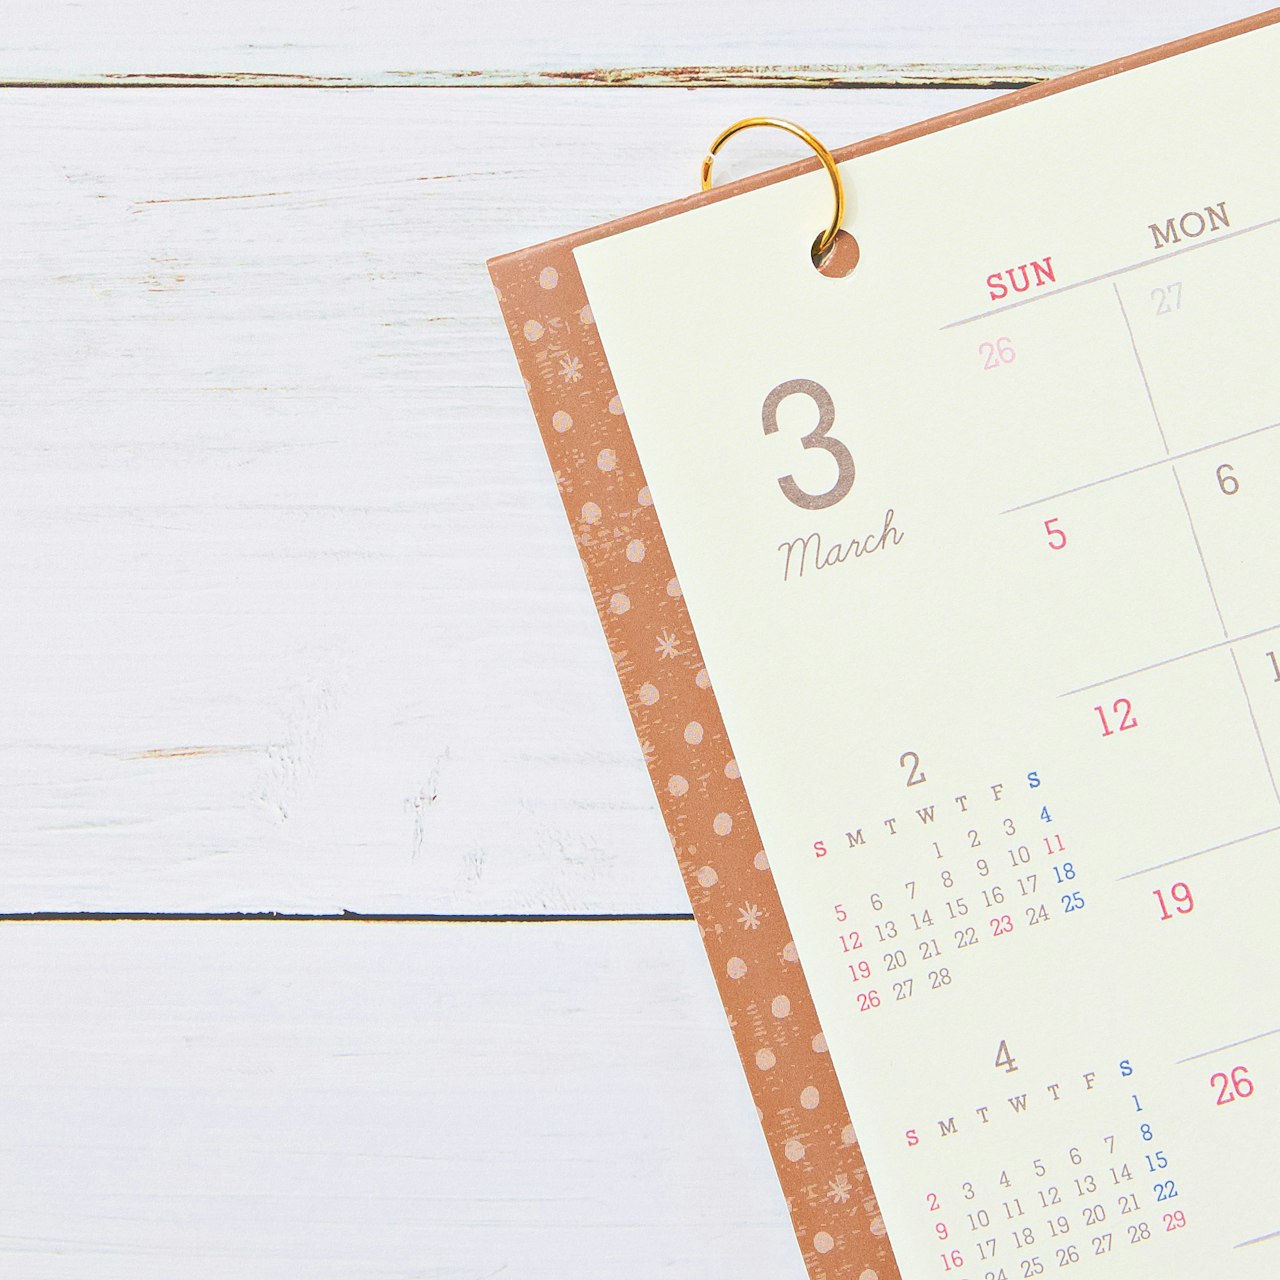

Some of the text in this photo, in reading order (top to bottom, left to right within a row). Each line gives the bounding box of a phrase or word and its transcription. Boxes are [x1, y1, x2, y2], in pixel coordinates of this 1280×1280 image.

[986, 256, 1057, 302] SUN
[1147, 201, 1232, 250] MON
[979, 337, 1016, 370] 26
[1150, 282, 1184, 316] 27
[761, 378, 856, 511] 3
[777, 508, 905, 582] March
[1043, 517, 1067, 551] 5
[1215, 463, 1240, 496] 6
[1093, 697, 1139, 738] 12
[899, 751, 927, 788] 2
[813, 770, 1041, 859] S M T W T F S
[932, 805, 1053, 860] 1 2 3 4
[833, 833, 1066, 923] 5 6 7 8 9 10 11
[838, 861, 1077, 953] 12 13 14 15 16 17 18
[1152, 881, 1195, 921] 19
[847, 890, 1086, 983] 19 20 21 22 23 24 25
[856, 967, 952, 1013] 26 27 28
[994, 1039, 1019, 1074] 4
[1209, 1065, 1255, 1107] 26
[905, 1059, 1134, 1148] S M T W T F S
[1131, 1094, 1144, 1113] 1
[926, 1123, 1154, 1212] 2 3 4 5 6 7 8
[935, 1150, 1168, 1241] 9 10 11 12 13 14 15
[940, 1179, 1179, 1272] 16 17 18 19 20 21 22
[1020, 1256, 1044, 1279] 25
[1055, 1244, 1080, 1268] 26
[1091, 1232, 1113, 1256] 27
[1127, 1221, 1152, 1245] 28
[1162, 1209, 1187, 1233] 29
